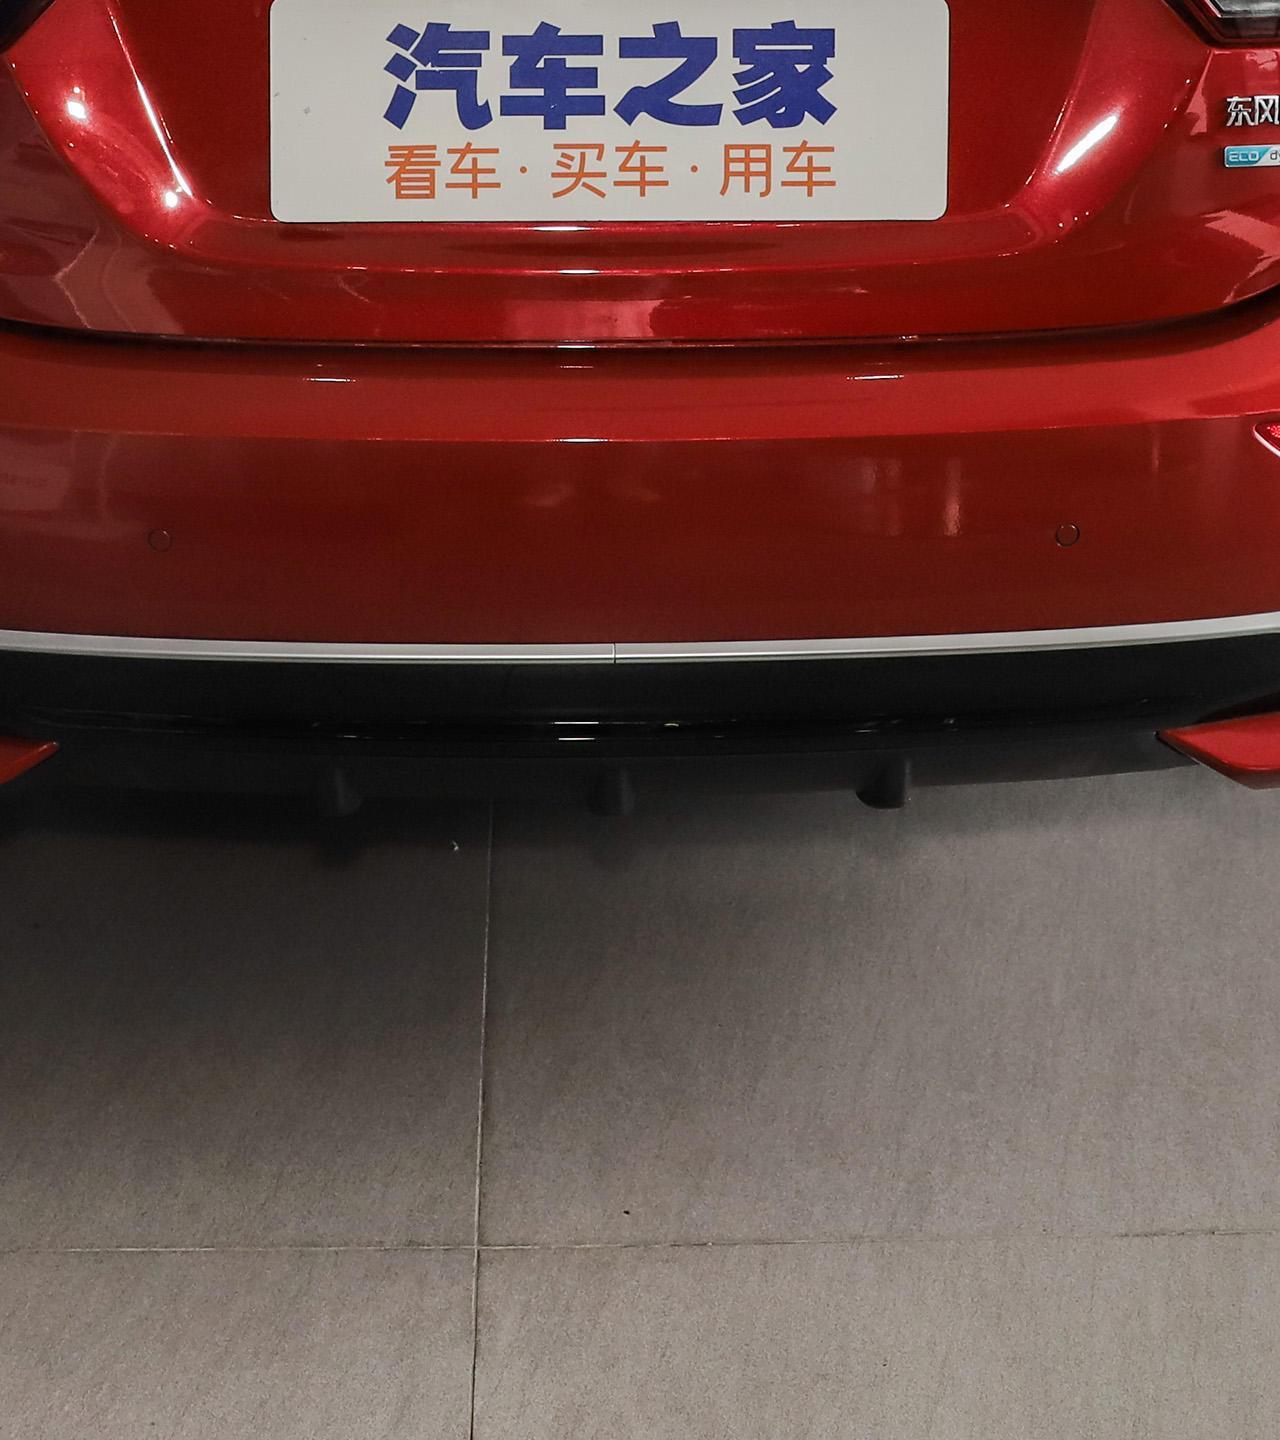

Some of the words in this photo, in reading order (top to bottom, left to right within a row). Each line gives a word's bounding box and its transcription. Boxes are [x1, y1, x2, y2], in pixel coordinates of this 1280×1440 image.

[383, 20, 838, 130] 汽车之家
[1228, 150, 1260, 162] ECO
